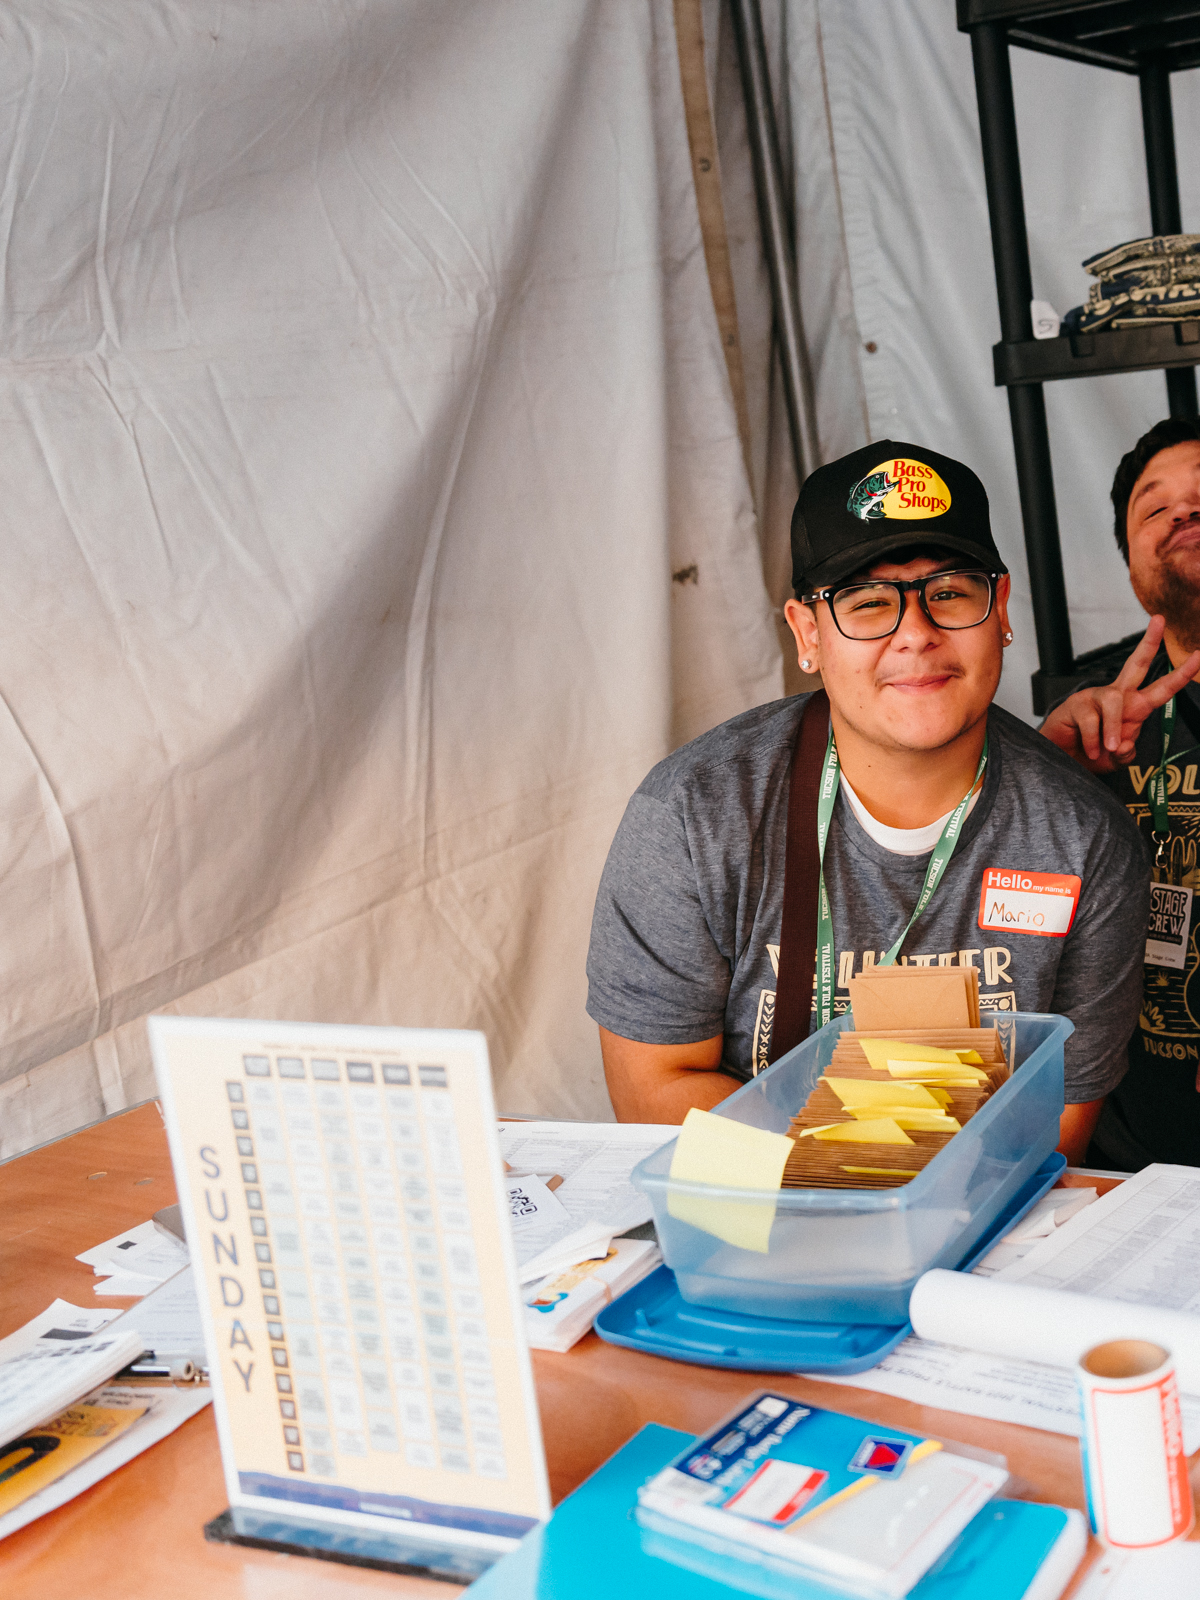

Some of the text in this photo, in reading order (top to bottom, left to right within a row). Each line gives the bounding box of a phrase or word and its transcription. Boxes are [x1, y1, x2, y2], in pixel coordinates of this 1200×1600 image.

[892, 460, 933, 479] Bass
[896, 477, 926, 493] Pro
[898, 492, 948, 512] Shops
[822, 768, 837, 800] TUCSON
[926, 858, 944, 889] TUCSON
[987, 871, 1033, 890] Hello
[1033, 885, 1043, 893] my
[1065, 887, 1072, 895] is
[988, 901, 1045, 927] Mario
[1150, 888, 1188, 917] STAGE
[1148, 912, 1185, 936] CREW
[821, 943, 831, 985] FESTIVAL
[821, 985, 831, 1006] FOLK
[821, 1007, 831, 1027] SON
[1142, 1035, 1199, 1060] TUCSON
[200, 1146, 255, 1393] SUNDAY
